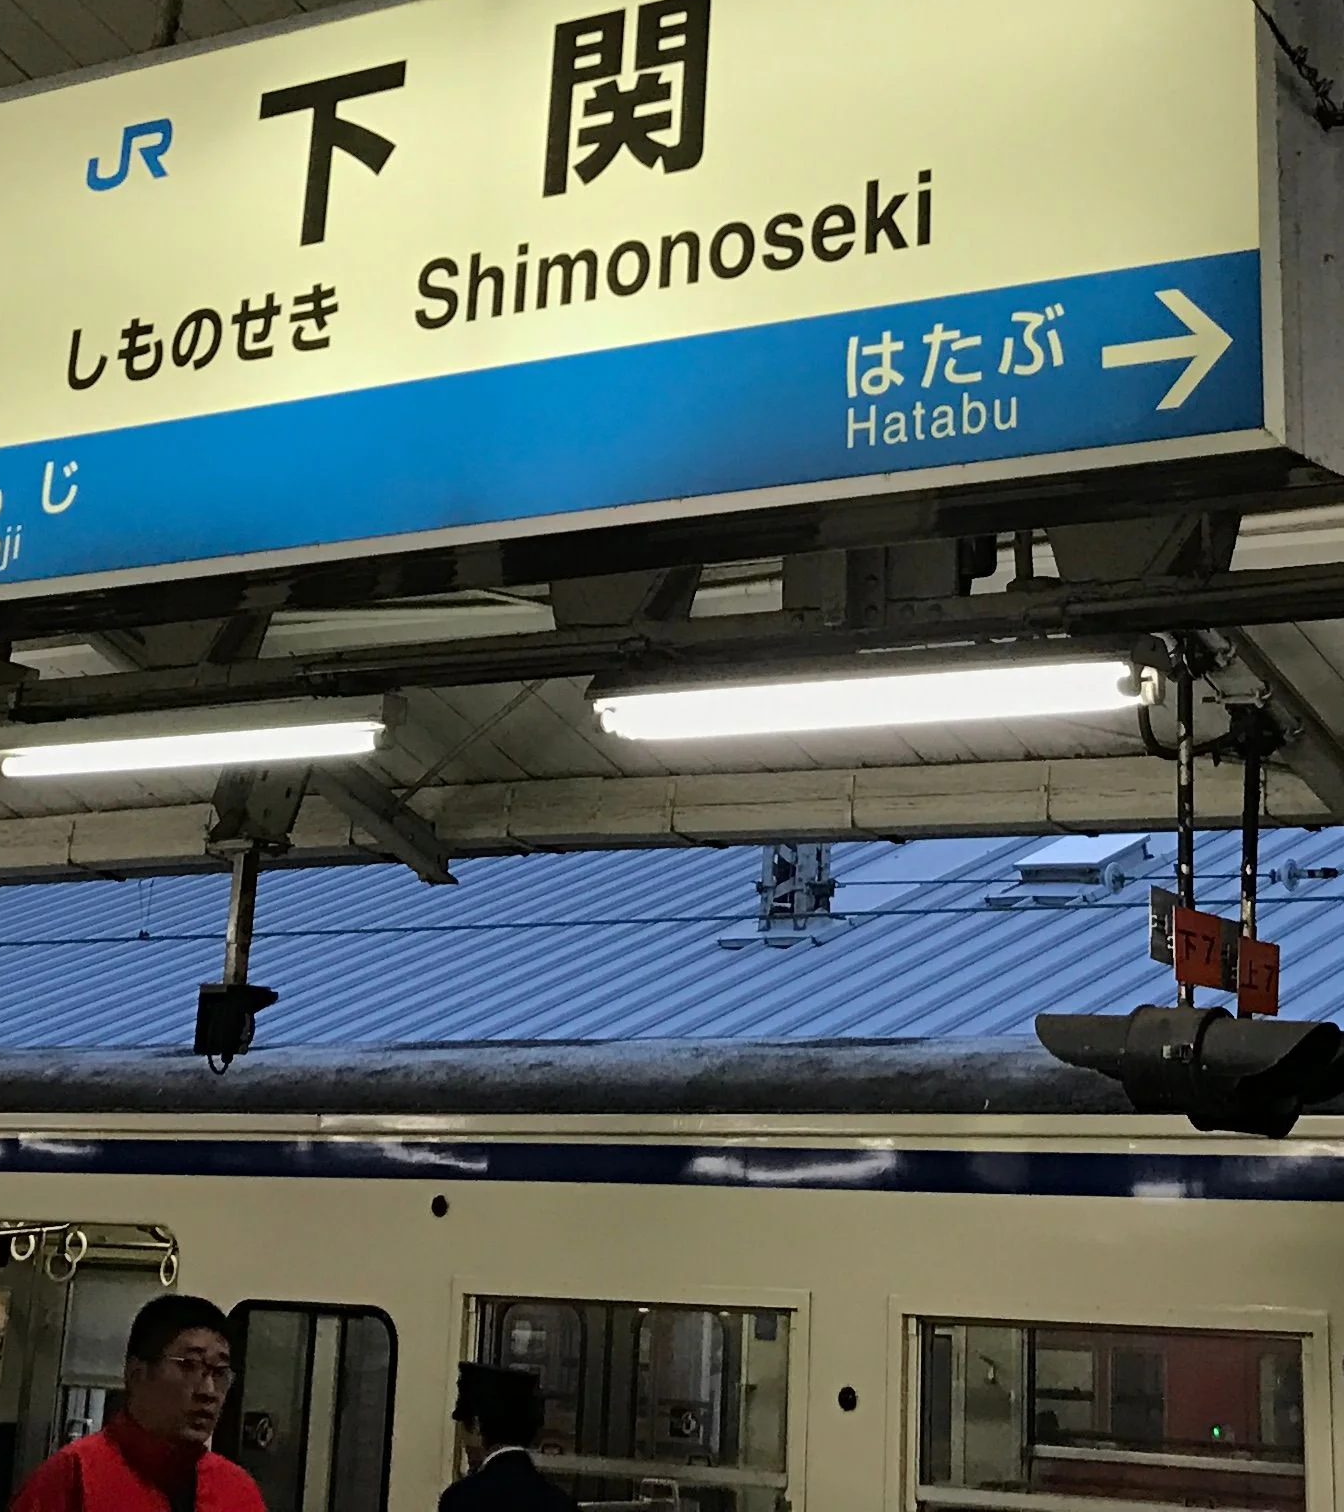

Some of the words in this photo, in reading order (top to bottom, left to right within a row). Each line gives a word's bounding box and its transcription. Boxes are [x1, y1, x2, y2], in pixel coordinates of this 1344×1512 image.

[86, 118, 173, 192] JR
[415, 168, 932, 330] Shimonoseki
[67, 283, 339, 391] しものせき
[846, 302, 1066, 399] はたぶ
[846, 391, 1018, 449] Hatabu
[1177, 928, 1216, 965] 下7
